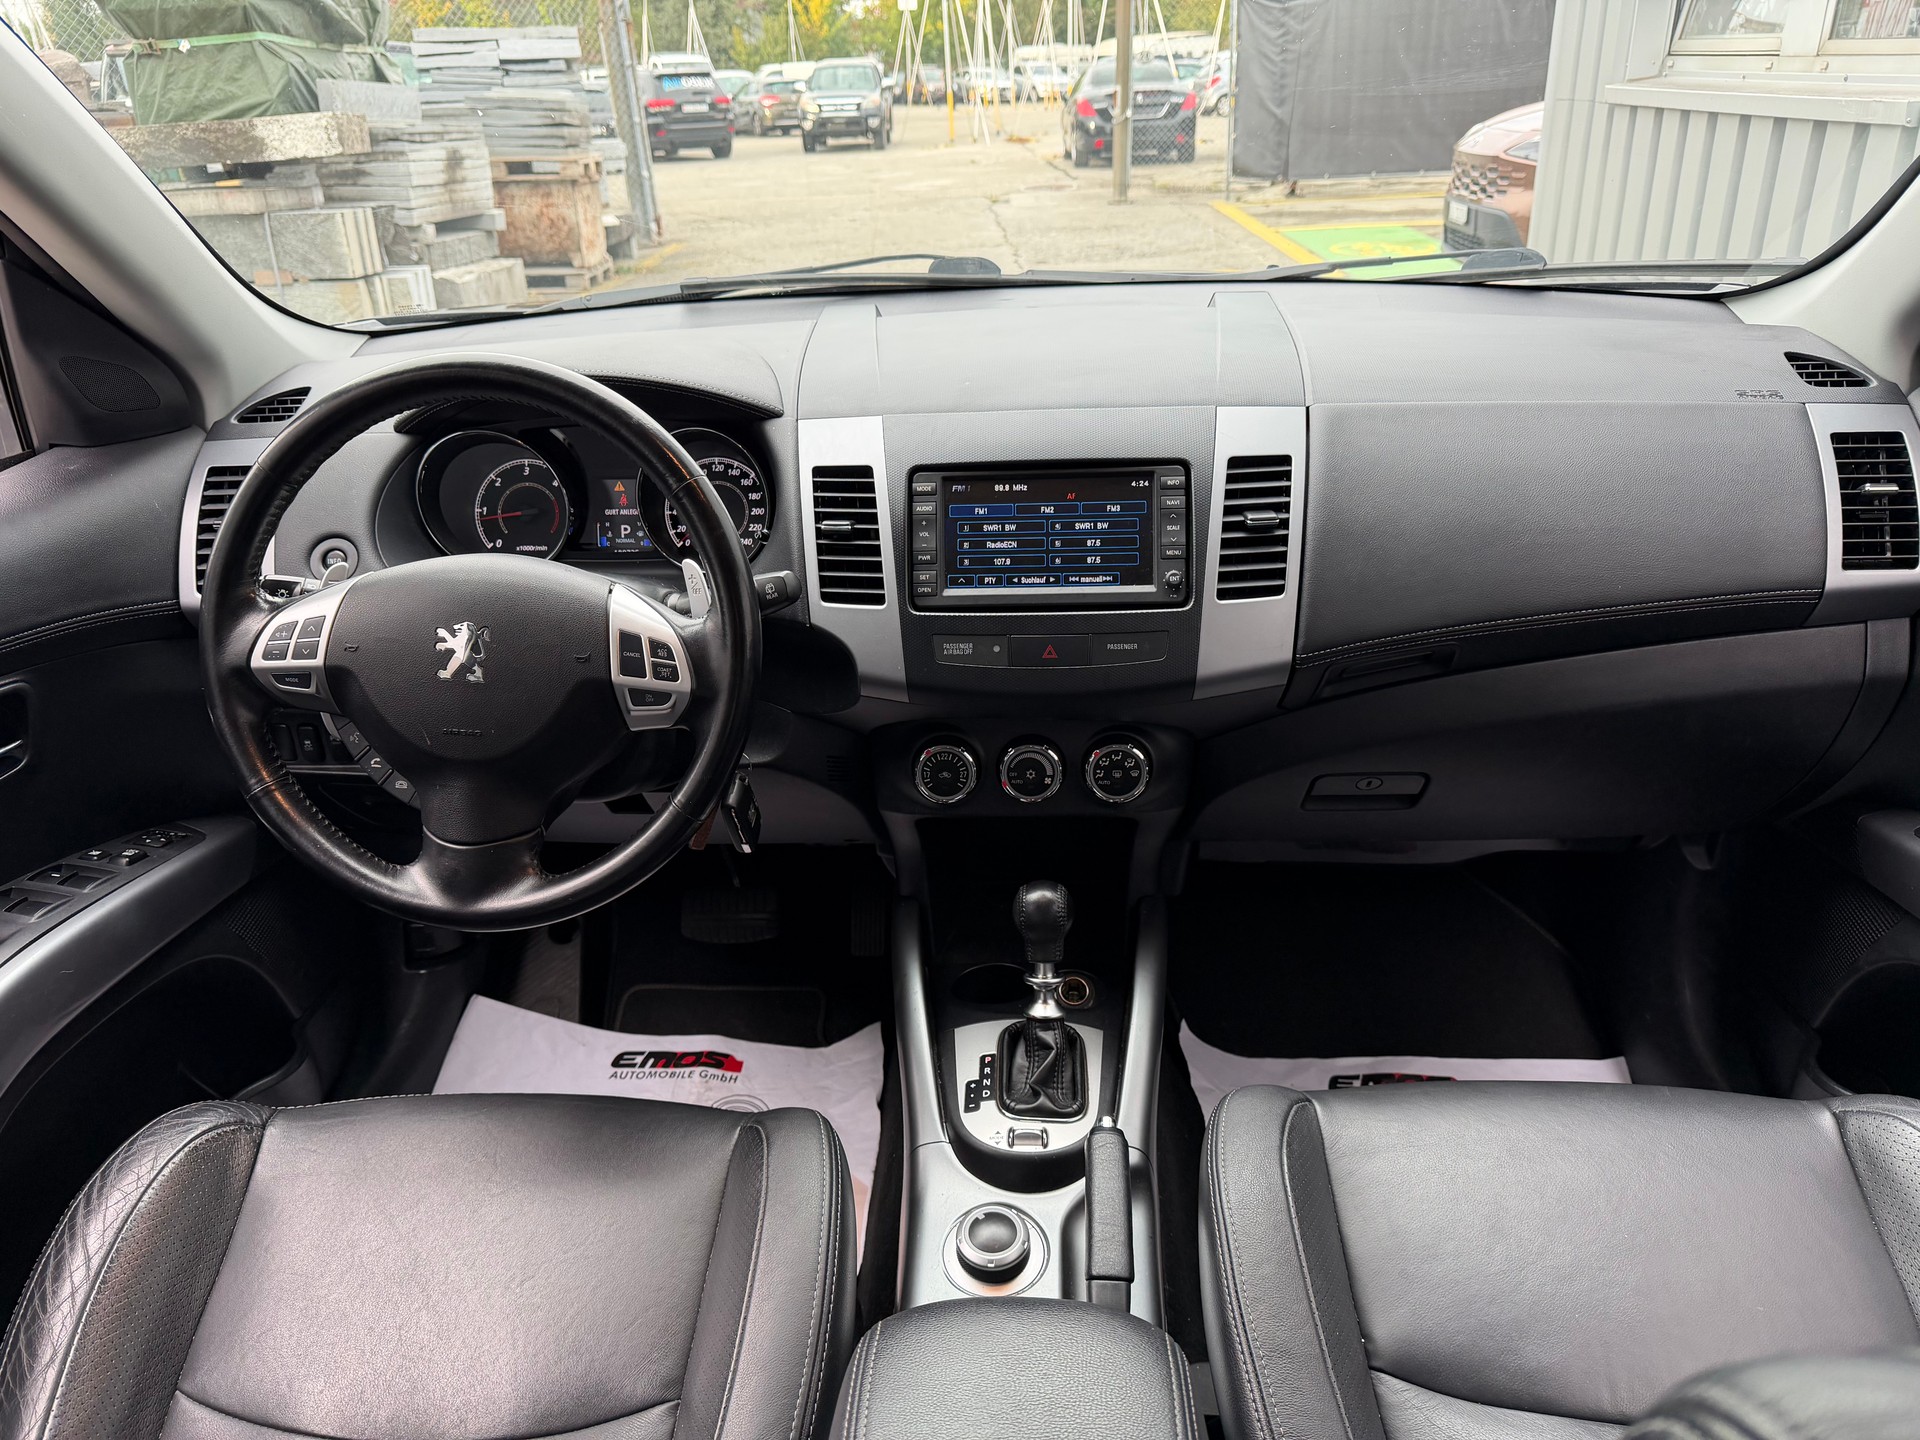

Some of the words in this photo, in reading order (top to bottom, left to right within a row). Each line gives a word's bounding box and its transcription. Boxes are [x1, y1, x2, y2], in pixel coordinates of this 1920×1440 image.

[523, 467, 530, 475] 3
[712, 464, 725, 472] 120
[495, 478, 502, 487] 2
[552, 480, 559, 488] 4
[740, 478, 753, 486] 160
[1012, 483, 1028, 491] MHz
[483, 507, 487, 515] 1
[974, 507, 988, 515] FM1
[1040, 506, 1055, 514] FM2
[677, 525, 687, 533] 20
[748, 524, 762, 532] 220
[983, 524, 1002, 532] SWR1
[1004, 524, 1017, 532] BW
[1097, 522, 1109, 530] BW
[620, 524, 631, 538] P
[495, 539, 503, 548] 0
[685, 539, 691, 547] 0
[986, 541, 1017, 549] RadioECN
[1086, 539, 1101, 547] 87.5
[1086, 556, 1101, 564] 87.5
[1021, 576, 1046, 584] Suchlauf
[985, 1056, 992, 1064] P
[609, 1069, 695, 1081] AUTOMOBILE
[699, 1069, 739, 1084] GmbH
[983, 1078, 991, 1086] N
[982, 1090, 990, 1098] D
